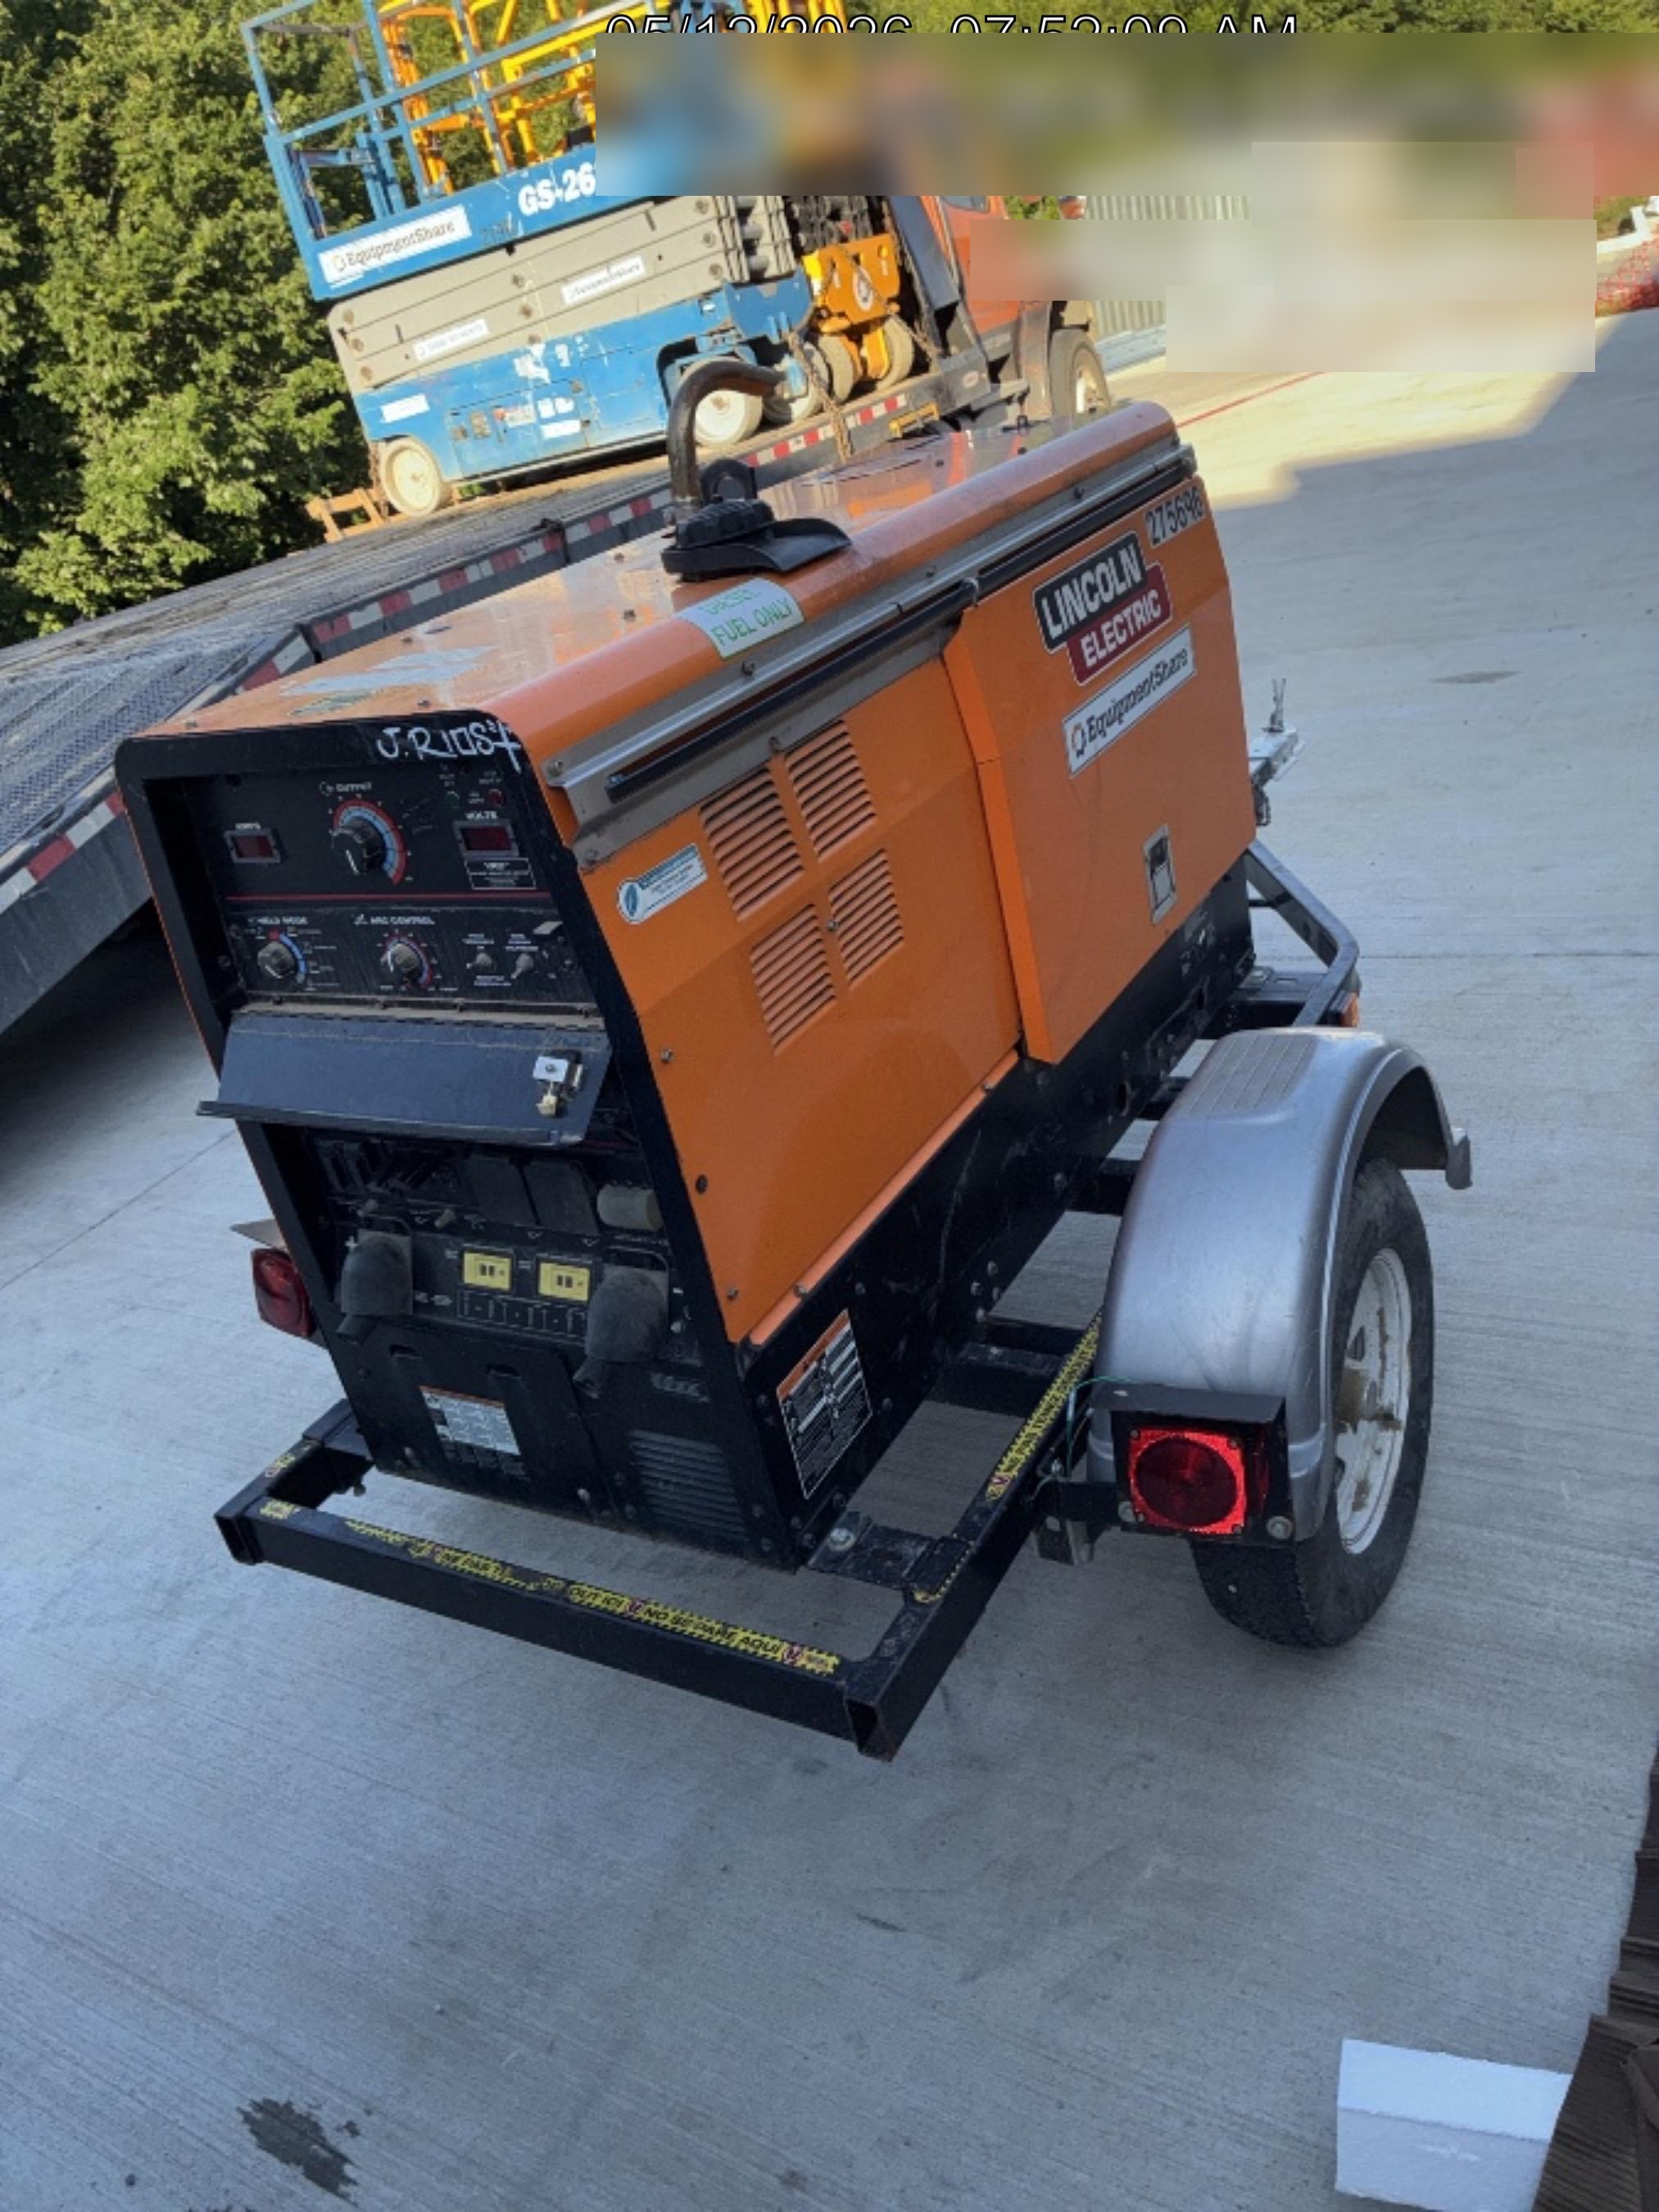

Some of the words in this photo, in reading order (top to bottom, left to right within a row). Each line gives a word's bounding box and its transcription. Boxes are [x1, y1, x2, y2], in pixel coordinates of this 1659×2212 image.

[518, 161, 596, 216] GS-26
[346, 220, 456, 265] EquipmentShare
[711, 614, 757, 646] FUEL
[754, 597, 792, 627] ONLY
[1041, 542, 1143, 640] LINCOLN
[1080, 589, 1162, 668] ELECTRIC
[1085, 647, 1189, 742] EquipmentShare
